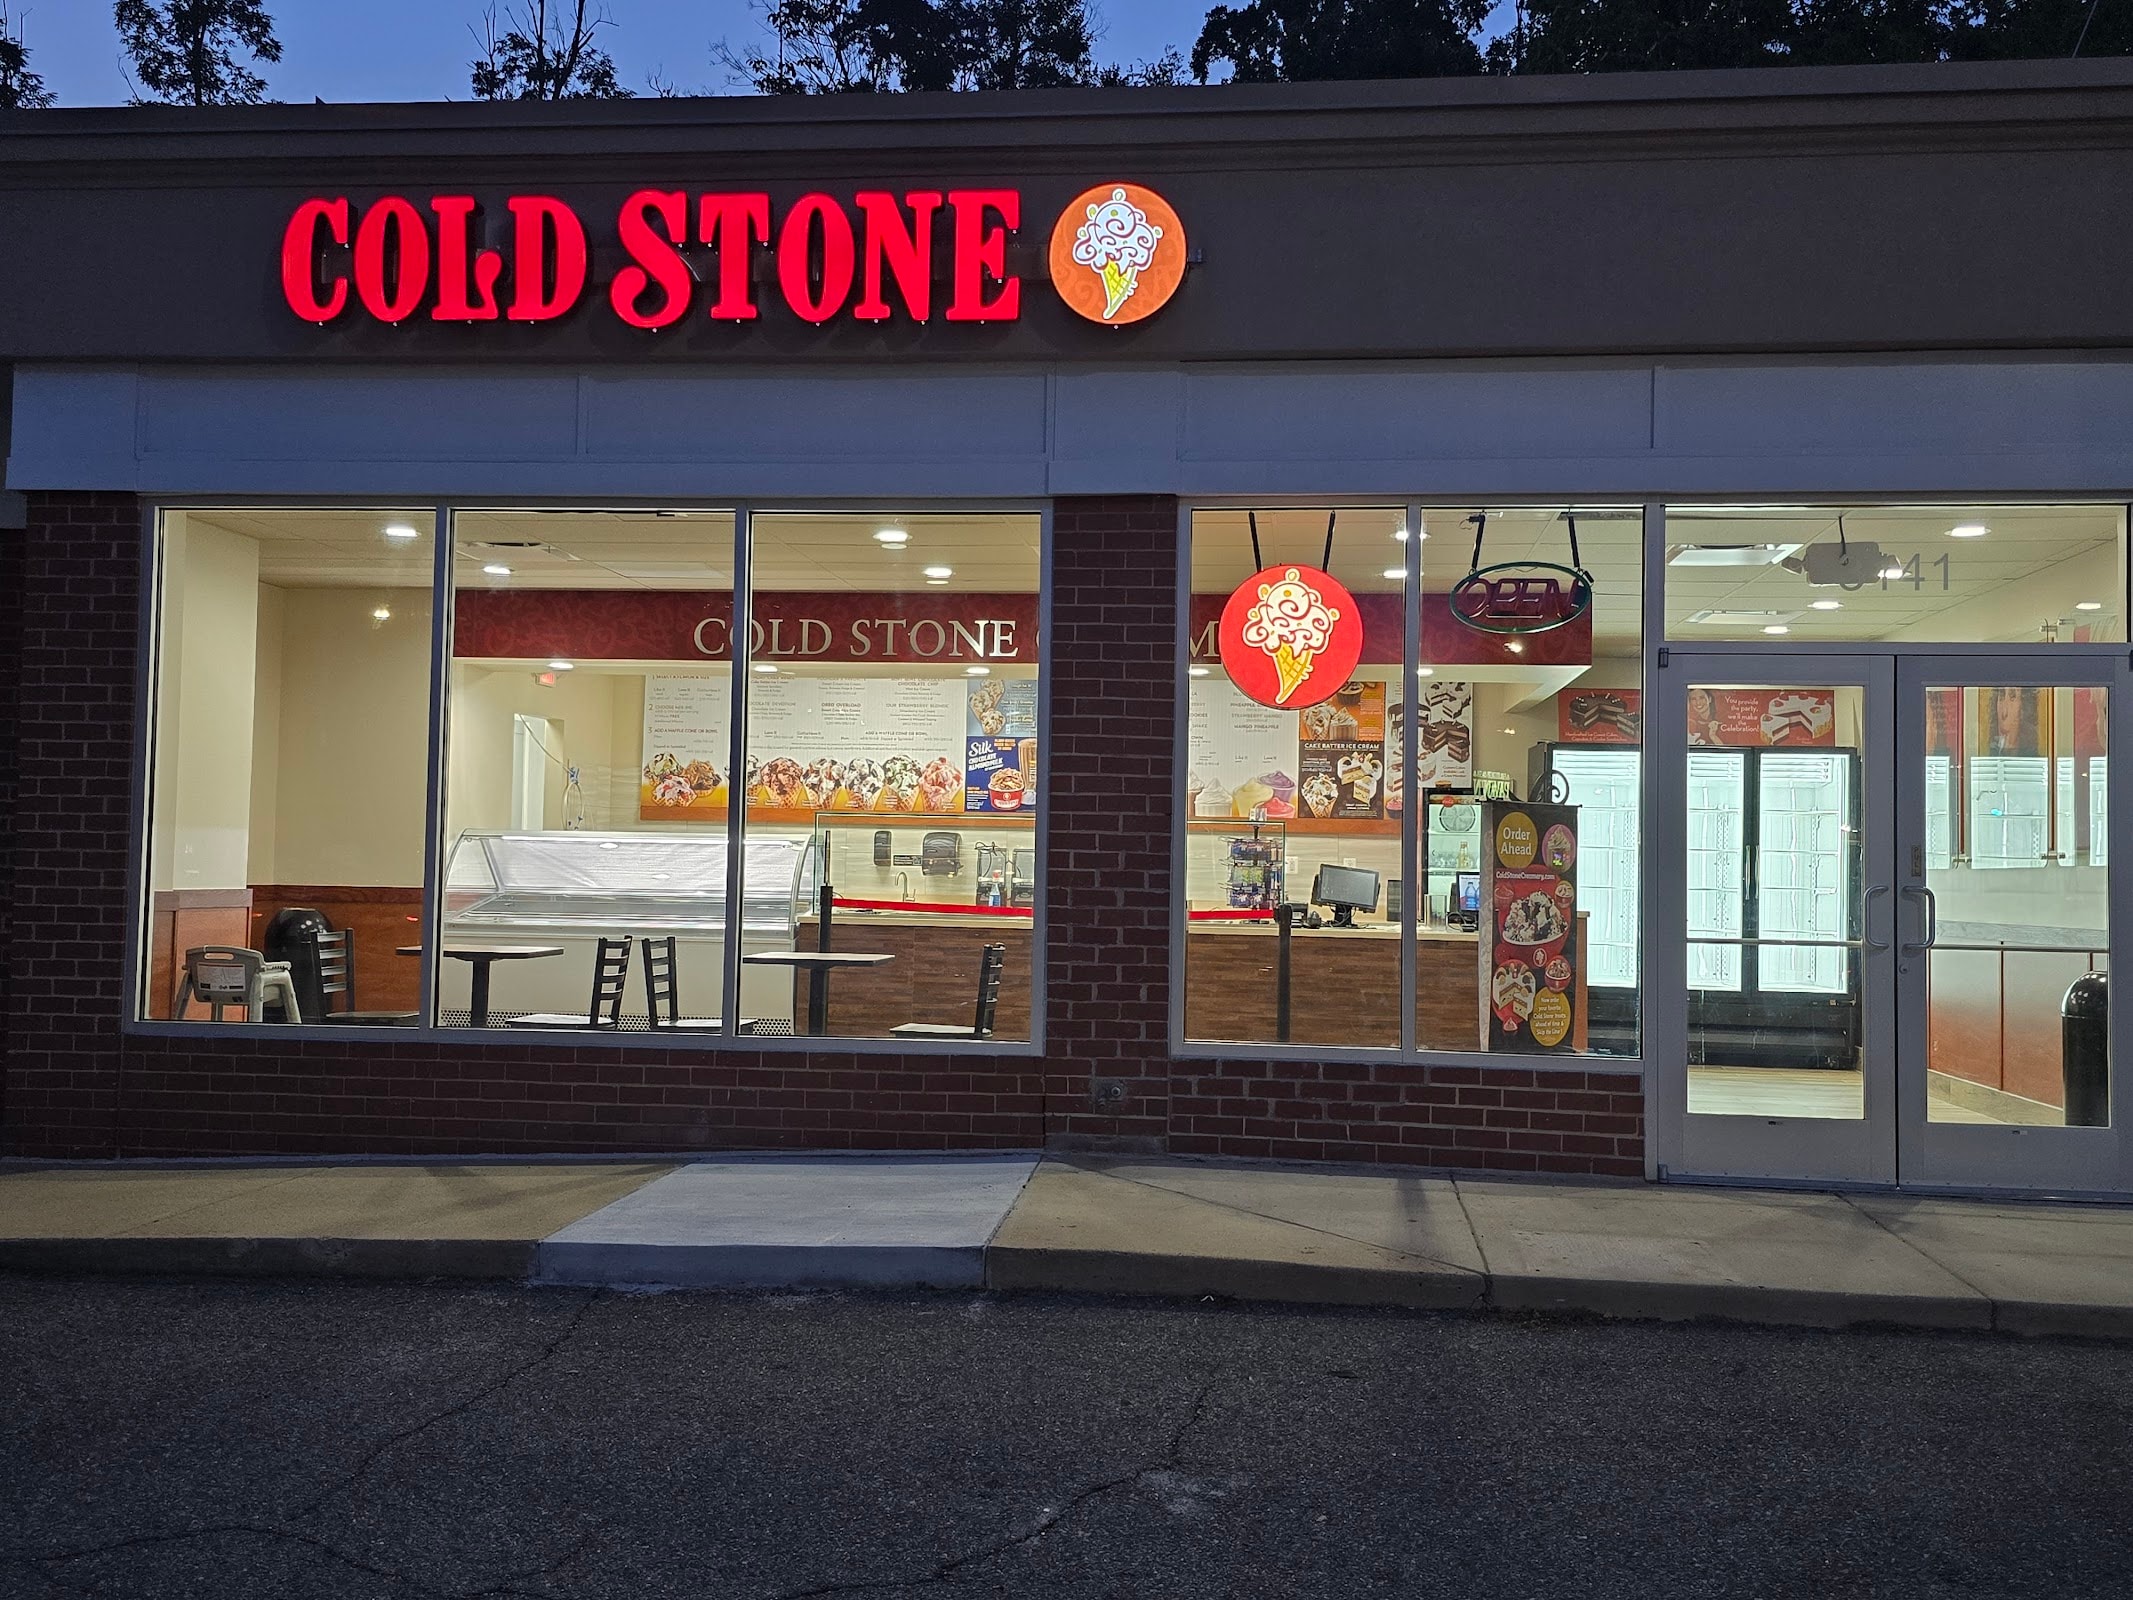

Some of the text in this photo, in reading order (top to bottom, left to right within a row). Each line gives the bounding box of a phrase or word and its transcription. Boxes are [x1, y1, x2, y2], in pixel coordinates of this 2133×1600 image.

[281, 189, 1020, 329] COLD STONE
[1841, 553, 1949, 591] 141
[1460, 578, 1581, 619] OPEN
[850, 619, 1018, 657] STONE
[1720, 724, 1759, 732] Celebration!
[968, 740, 994, 757] Silk
[1503, 827, 1530, 840] Order
[1501, 842, 1532, 855] Ahead
